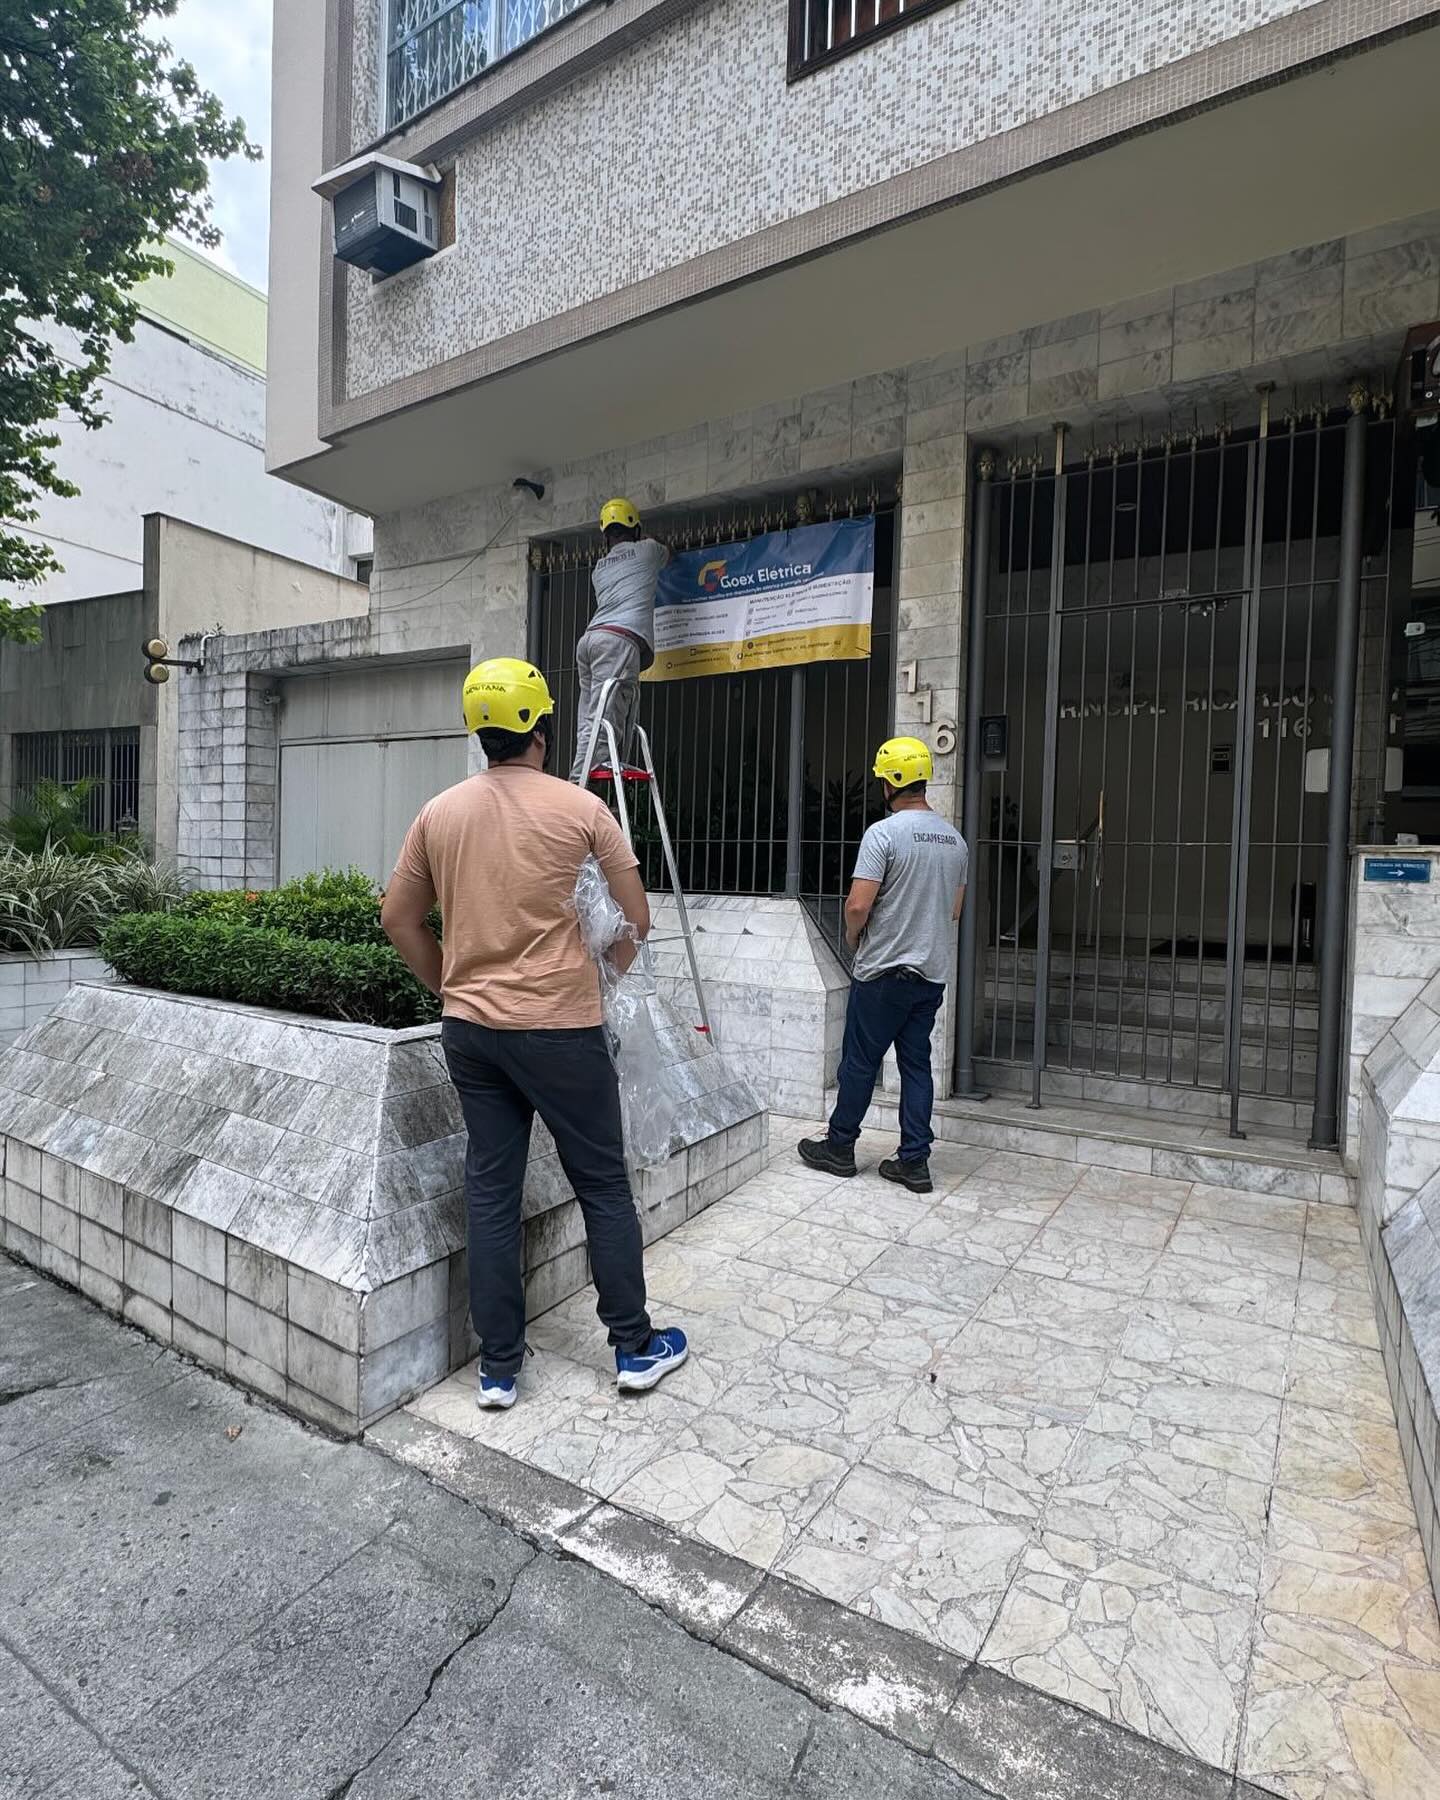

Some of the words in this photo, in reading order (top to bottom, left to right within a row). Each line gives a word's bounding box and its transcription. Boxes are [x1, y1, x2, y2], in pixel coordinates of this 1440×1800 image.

[720, 573, 755, 589] Goex
[757, 562, 812, 583] Elétrica
[1257, 717, 1313, 738] 116
